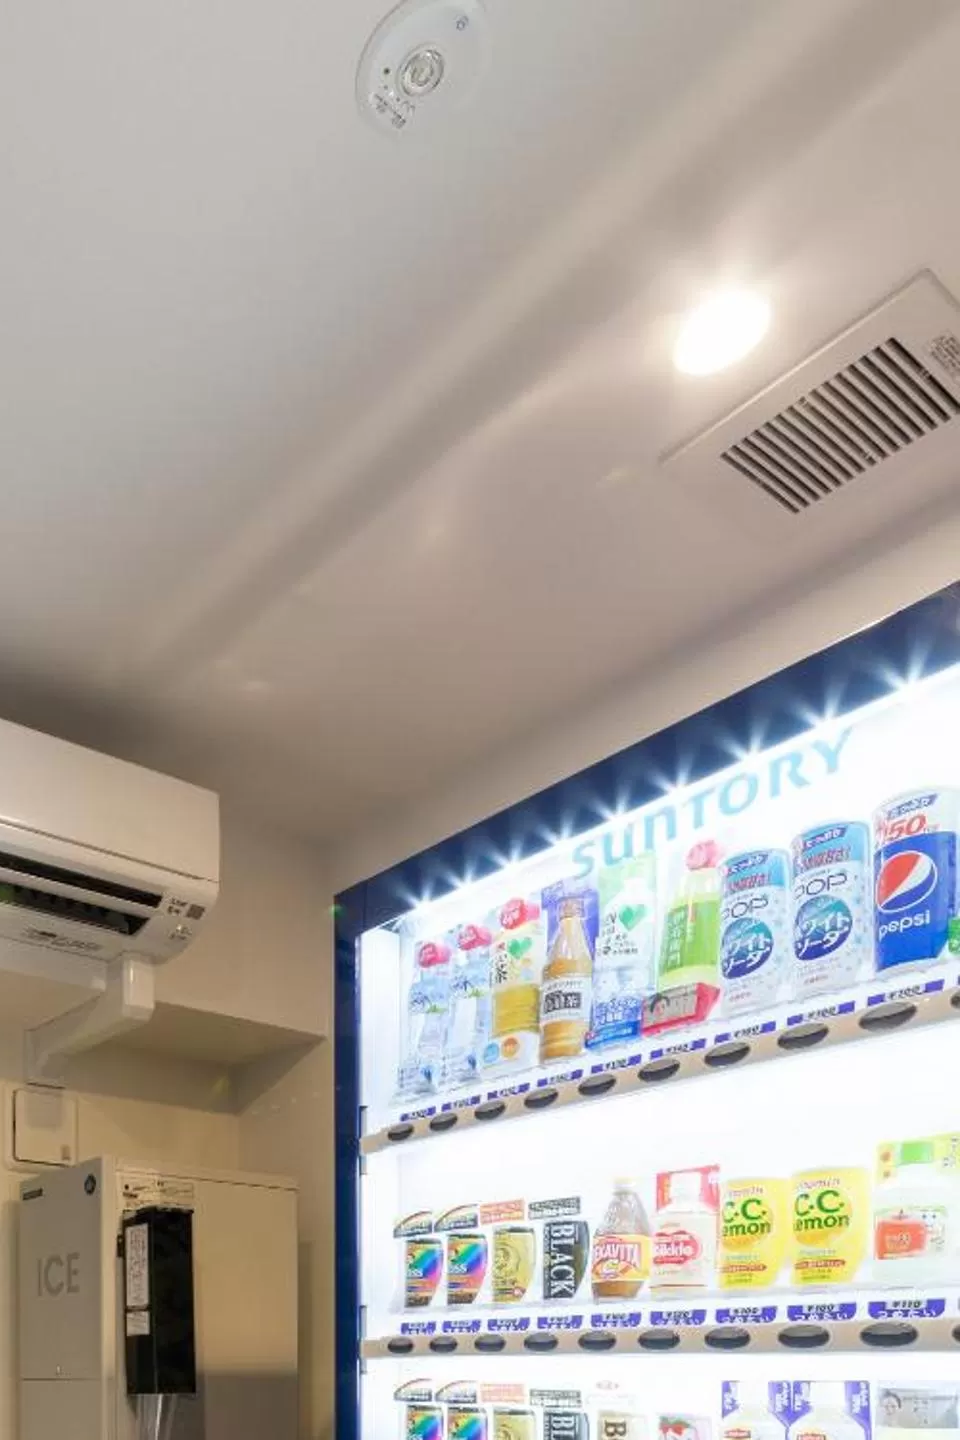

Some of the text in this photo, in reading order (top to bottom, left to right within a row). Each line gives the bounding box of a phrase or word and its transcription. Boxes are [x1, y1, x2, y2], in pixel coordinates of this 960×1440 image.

[571, 729, 855, 880] SUNTORY
[878, 910, 931, 942] pepsi
[722, 1220, 771, 1237] emon
[793, 1214, 850, 1233] emon
[37, 1251, 80, 1297] ICE
[550, 1223, 576, 1298] BLACK
